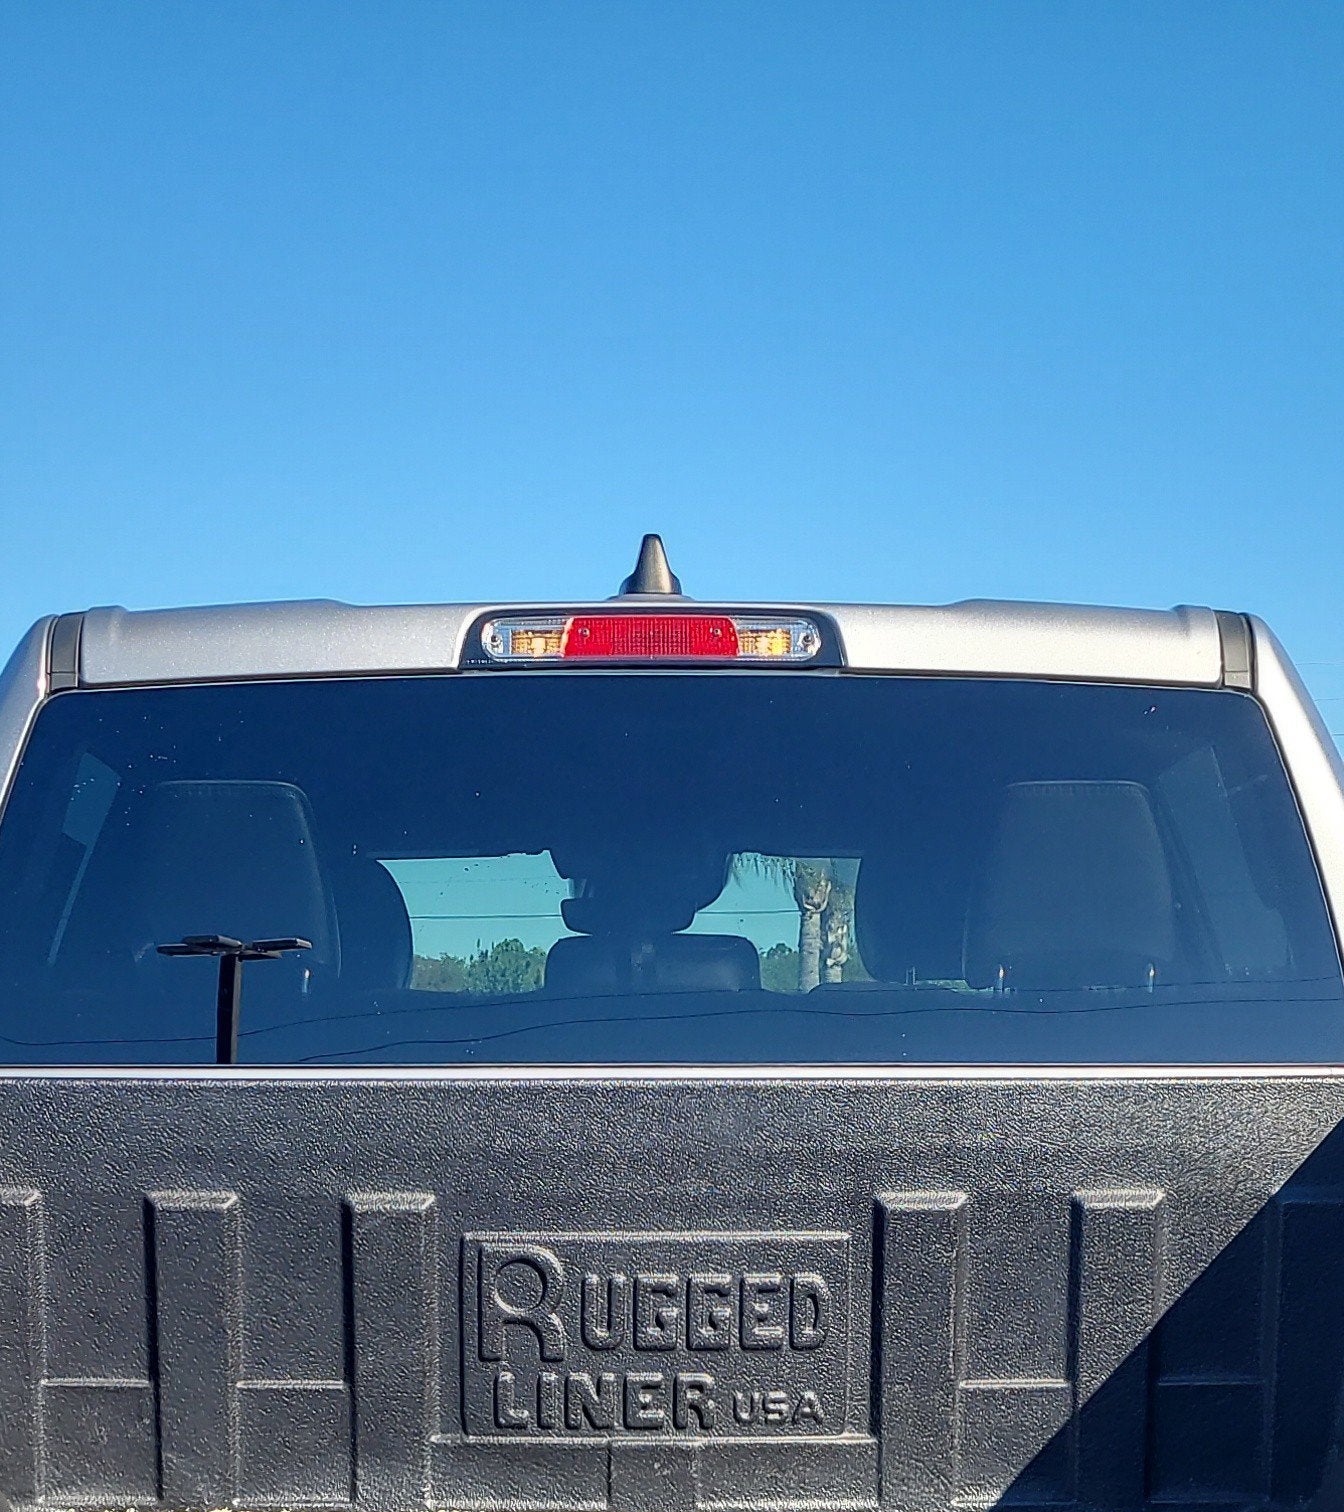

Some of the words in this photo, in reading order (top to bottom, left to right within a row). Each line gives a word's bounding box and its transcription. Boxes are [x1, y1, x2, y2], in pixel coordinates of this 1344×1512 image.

[477, 1242, 833, 1363] RUGGED
[492, 1371, 716, 1431] LINER
[731, 1389, 825, 1426] USA
